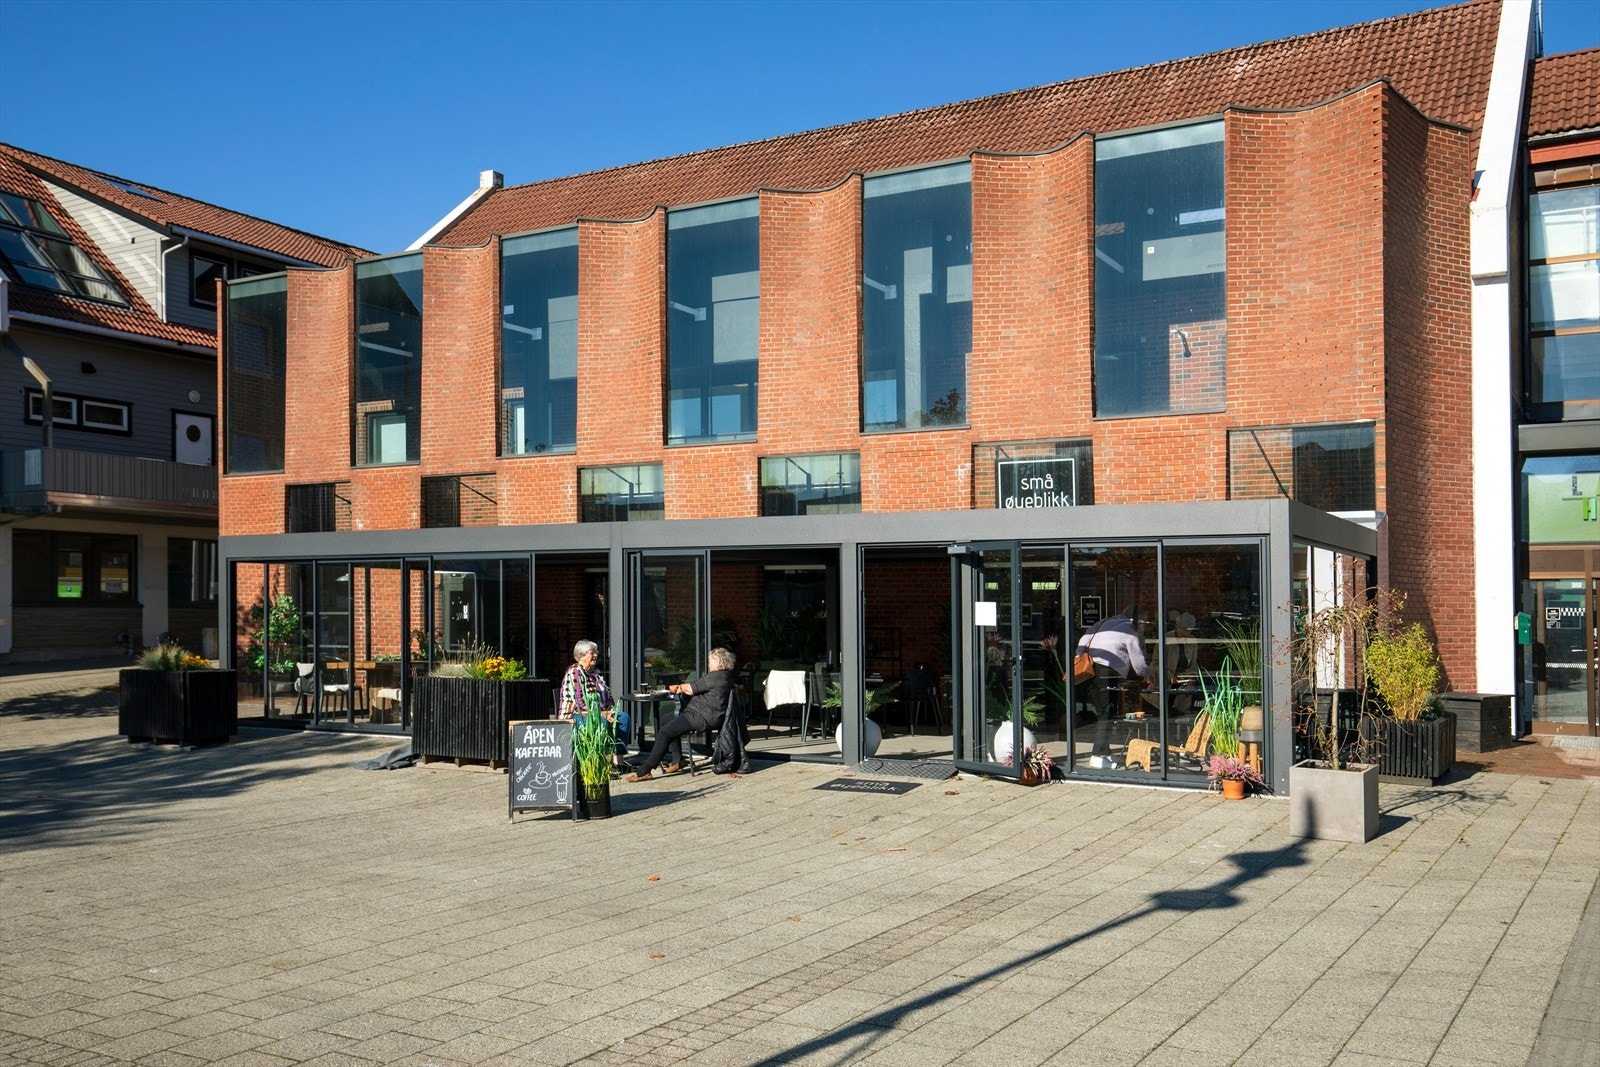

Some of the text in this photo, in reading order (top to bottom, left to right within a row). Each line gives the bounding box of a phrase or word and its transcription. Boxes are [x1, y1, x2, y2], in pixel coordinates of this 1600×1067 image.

[1021, 473, 1054, 490] små
[523, 725, 555, 745] ÅPEN
[515, 746, 562, 759] KAFFEBAR
[517, 793, 537, 801] COFFEE
